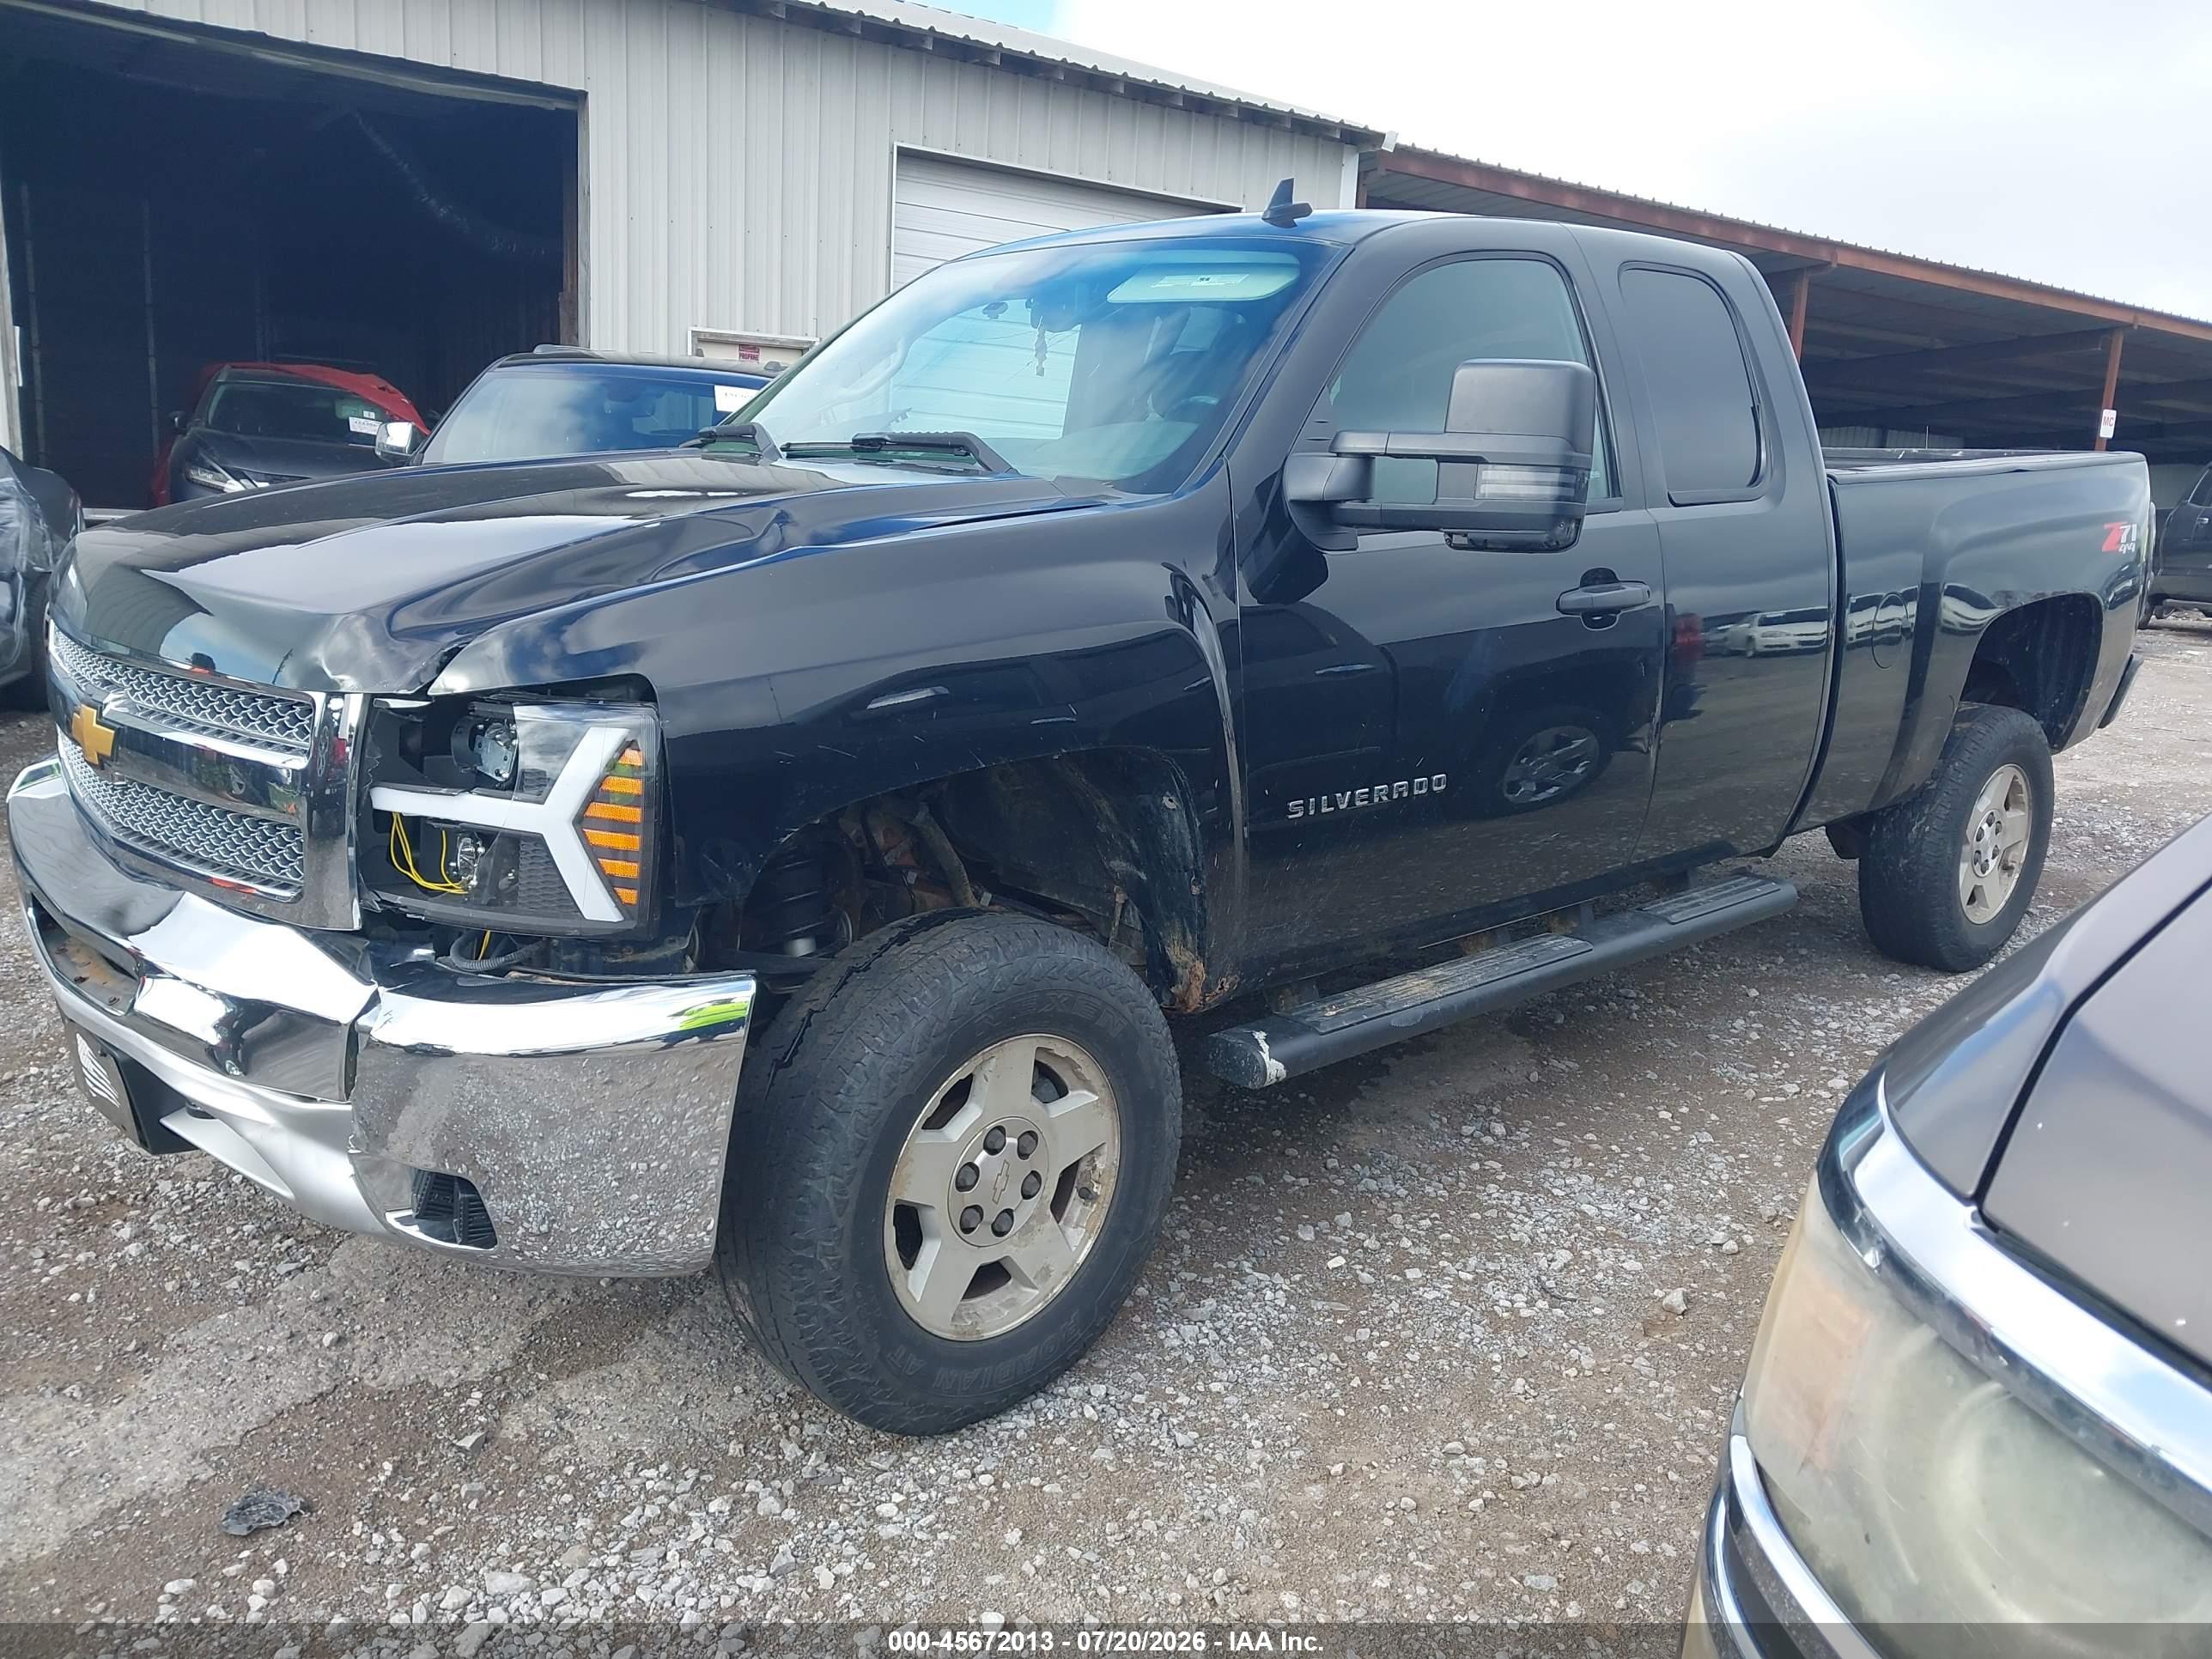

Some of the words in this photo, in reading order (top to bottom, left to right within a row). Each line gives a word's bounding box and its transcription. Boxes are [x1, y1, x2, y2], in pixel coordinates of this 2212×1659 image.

[739, 352, 759, 362] PROPANE
[2103, 416, 2114, 426] MC
[2102, 522, 2136, 552] Z71
[1287, 774, 1447, 819] SILVERADO
[974, 994, 1127, 1036] NEXEN
